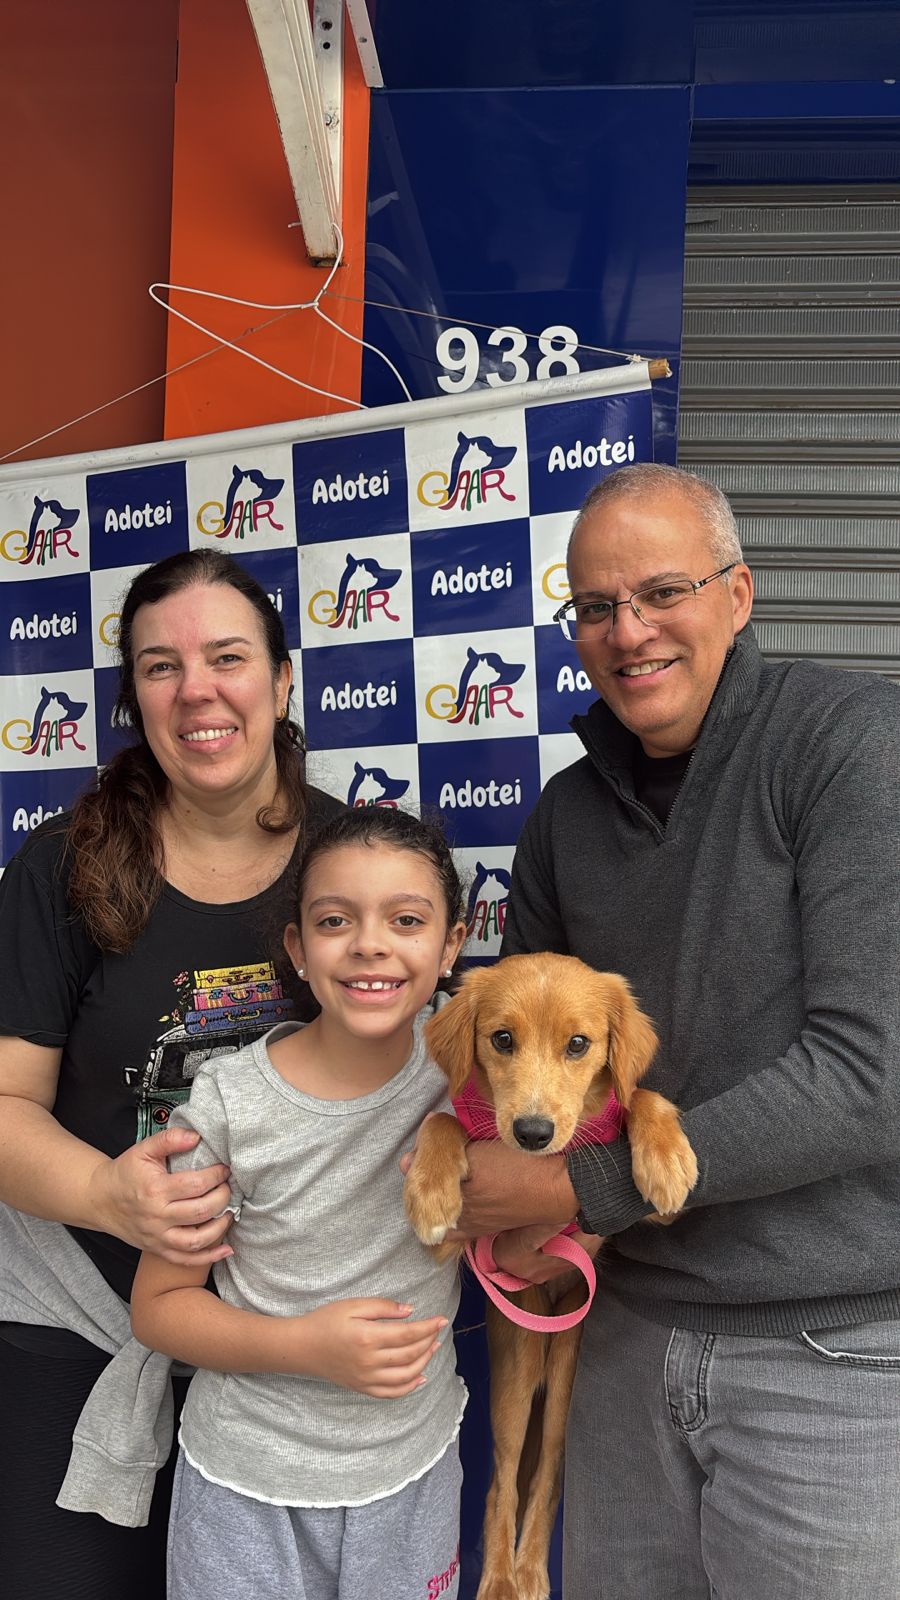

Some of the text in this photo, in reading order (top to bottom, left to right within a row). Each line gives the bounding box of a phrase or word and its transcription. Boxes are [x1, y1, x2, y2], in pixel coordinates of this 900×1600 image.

[436, 325, 580, 393] 938
[547, 435, 635, 473] Adotei
[312, 470, 389, 504] Adotei
[417, 468, 515, 511] GAAR
[105, 500, 172, 533] Adotei
[196, 500, 284, 539] GAAR
[0, 529, 80, 565] GAAR
[431, 562, 512, 596] Adotei
[10, 612, 78, 640] Adotei
[307, 589, 400, 629] GAAR
[320, 681, 397, 712] Adotei
[425, 684, 524, 726] GAAR
[1, 719, 87, 757] GAAR
[439, 779, 521, 809] Adotei
